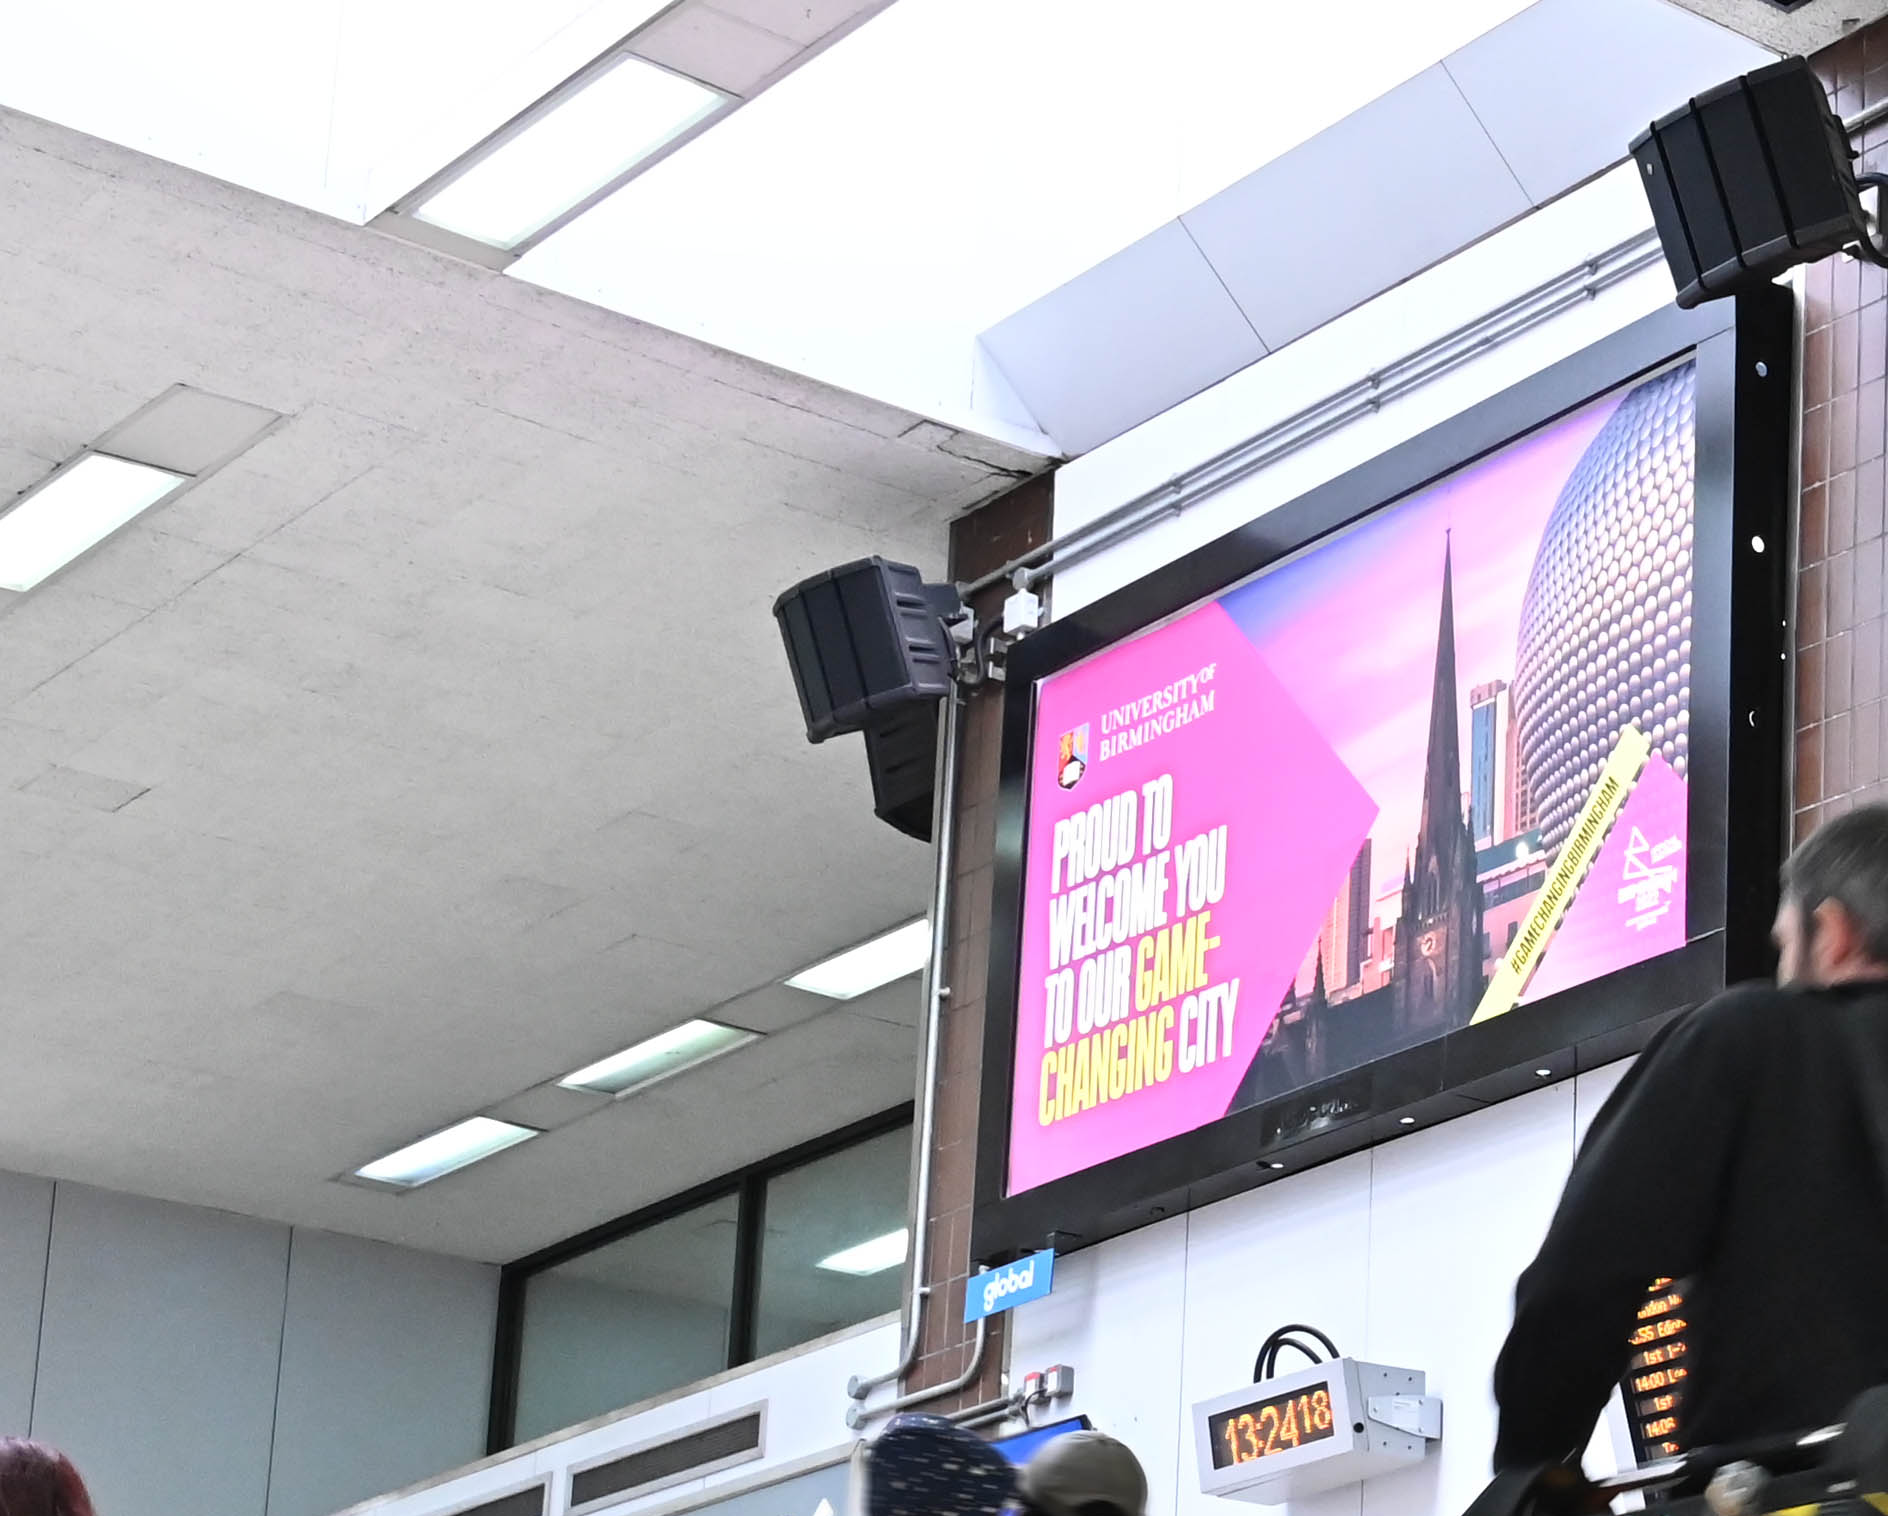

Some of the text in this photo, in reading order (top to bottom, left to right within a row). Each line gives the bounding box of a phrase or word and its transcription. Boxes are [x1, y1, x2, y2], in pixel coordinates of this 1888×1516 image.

[1099, 689, 1216, 763] BIRMINGHAM
[1101, 672, 1200, 735] UNIVERSITY
[1049, 824, 1228, 971] WELCOME YOU
[1051, 773, 1174, 895] PROUD TO
[1510, 775, 1620, 976] #GAMECHANGINGBIRMINGHAM
[1044, 910, 1221, 1049] TO OUR GAME-
[1038, 977, 1241, 1127] CHANGING CITY
[983, 1259, 1035, 1312] global
